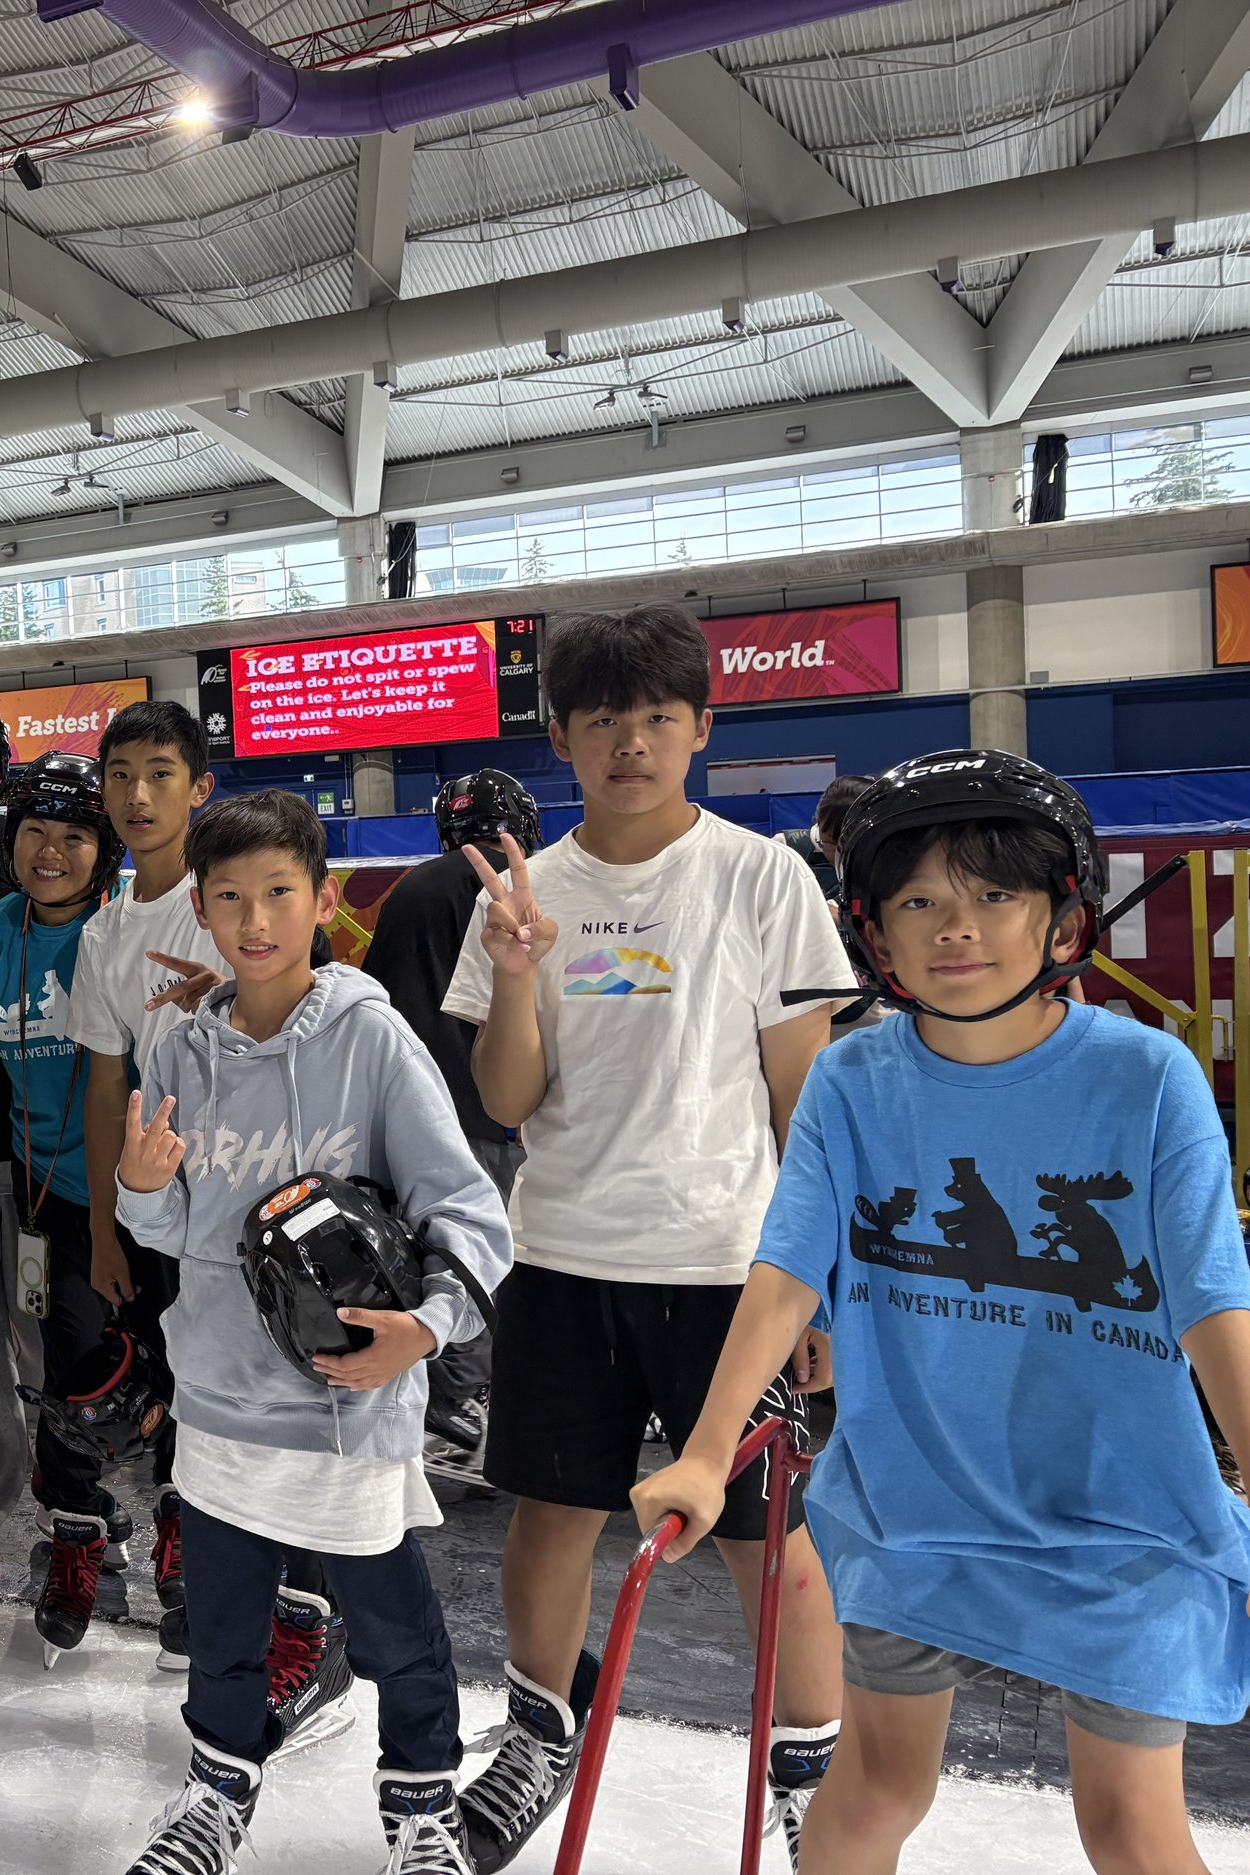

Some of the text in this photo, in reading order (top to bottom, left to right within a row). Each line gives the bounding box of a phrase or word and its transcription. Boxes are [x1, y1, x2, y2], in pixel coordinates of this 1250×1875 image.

[246, 655, 295, 677] ICE
[302, 636, 477, 672] ETIQUETTE
[720, 639, 826, 674] World
[250, 663, 476, 693] Please do not spit or spew
[499, 667, 534, 676] CALGARY
[250, 681, 446, 709] on the ice. Let's keep it
[251, 698, 455, 725] clean and enjoyable for
[502, 710, 536, 722] Canada
[16, 711, 100, 738] Fastest
[906, 759, 986, 778] CCM
[39, 782, 78, 794] CCM
[320, 804, 332, 812] EXIT
[581, 922, 628, 934] NIKE
[848, 1282, 870, 1303] AN
[1046, 1310, 1073, 1335] IN
[1091, 1320, 1185, 1363] CANADA
[58, 1521, 93, 1531] BAUER
[276, 1598, 311, 1615] AUER
[194, 1753, 241, 1779] BAUER
[390, 1784, 444, 1799] BAUER
